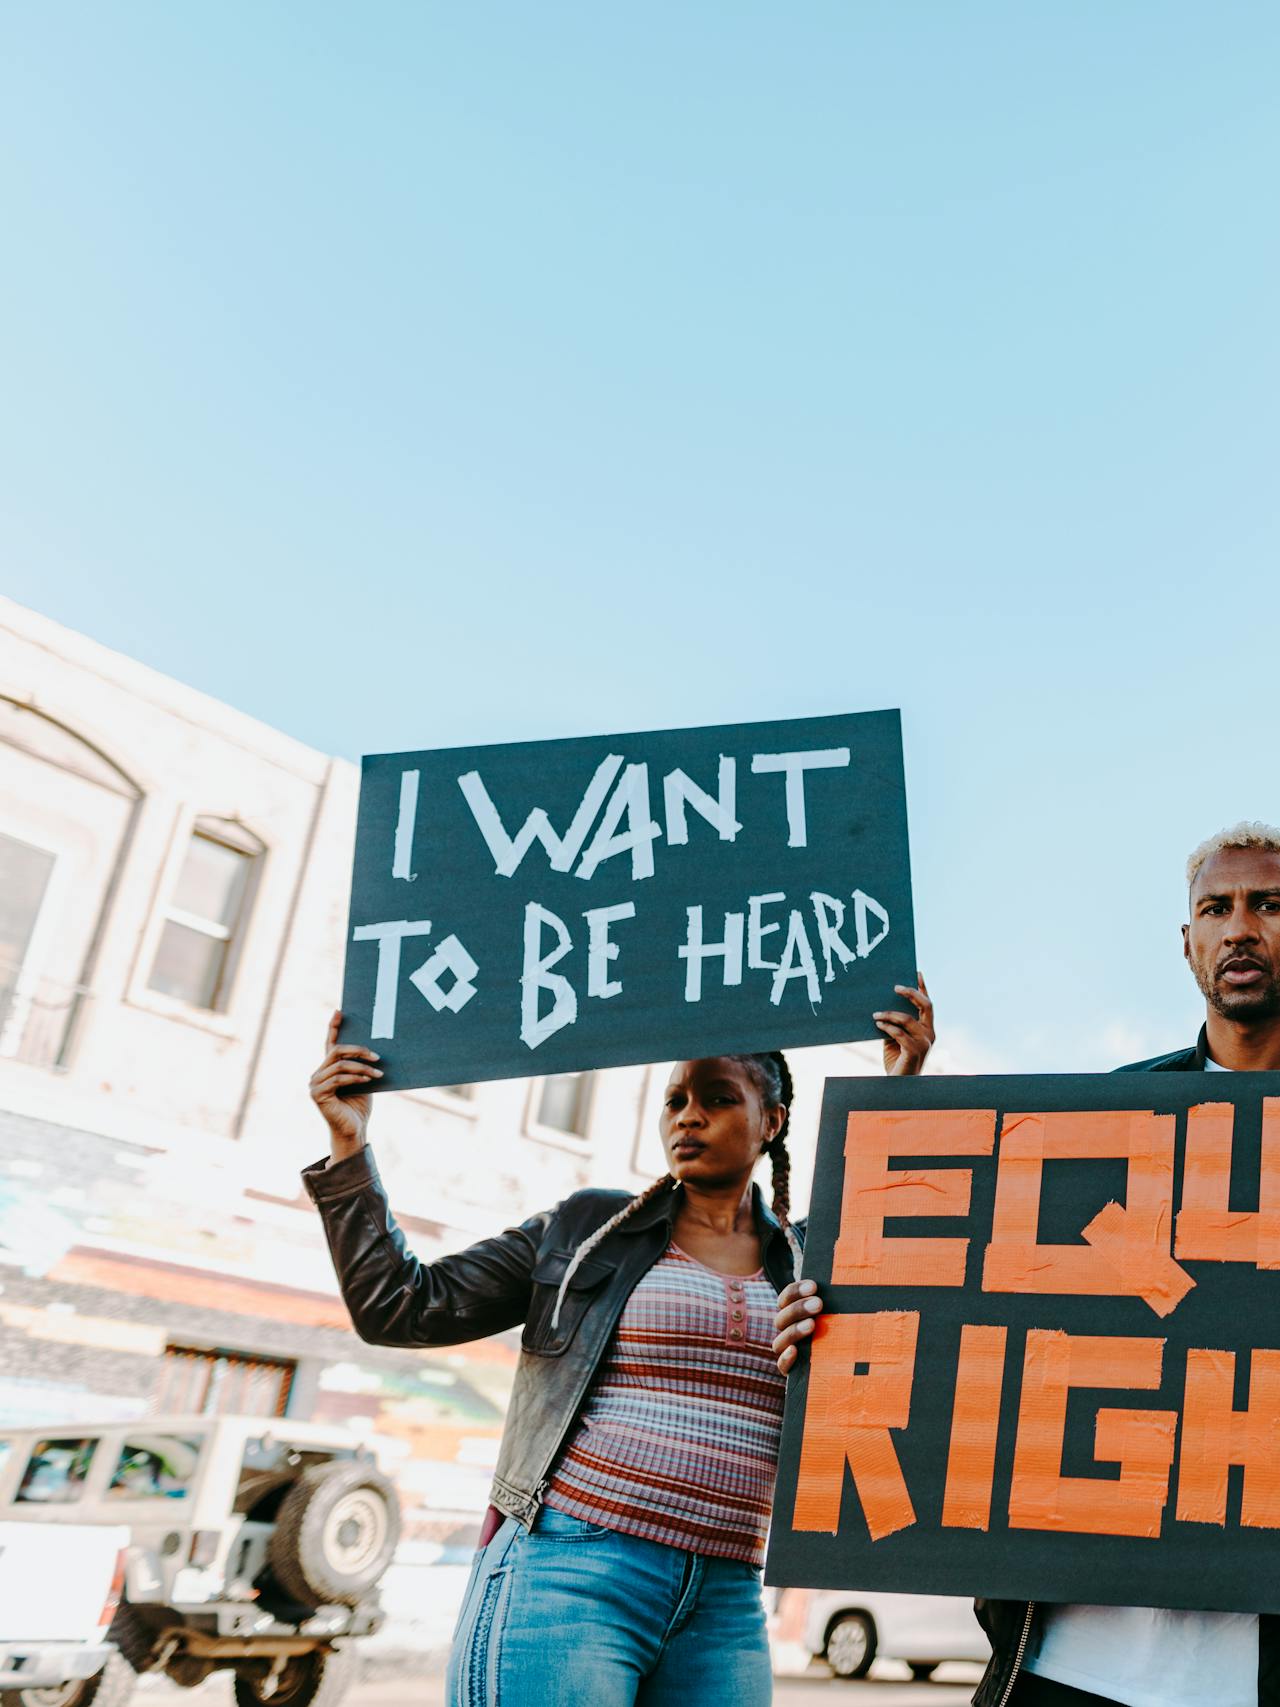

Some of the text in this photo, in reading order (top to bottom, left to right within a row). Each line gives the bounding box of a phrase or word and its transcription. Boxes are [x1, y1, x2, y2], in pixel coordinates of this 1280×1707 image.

[392, 747, 850, 880] I WANT
[520, 901, 635, 1050] BE
[678, 889, 889, 1005] HEARD
